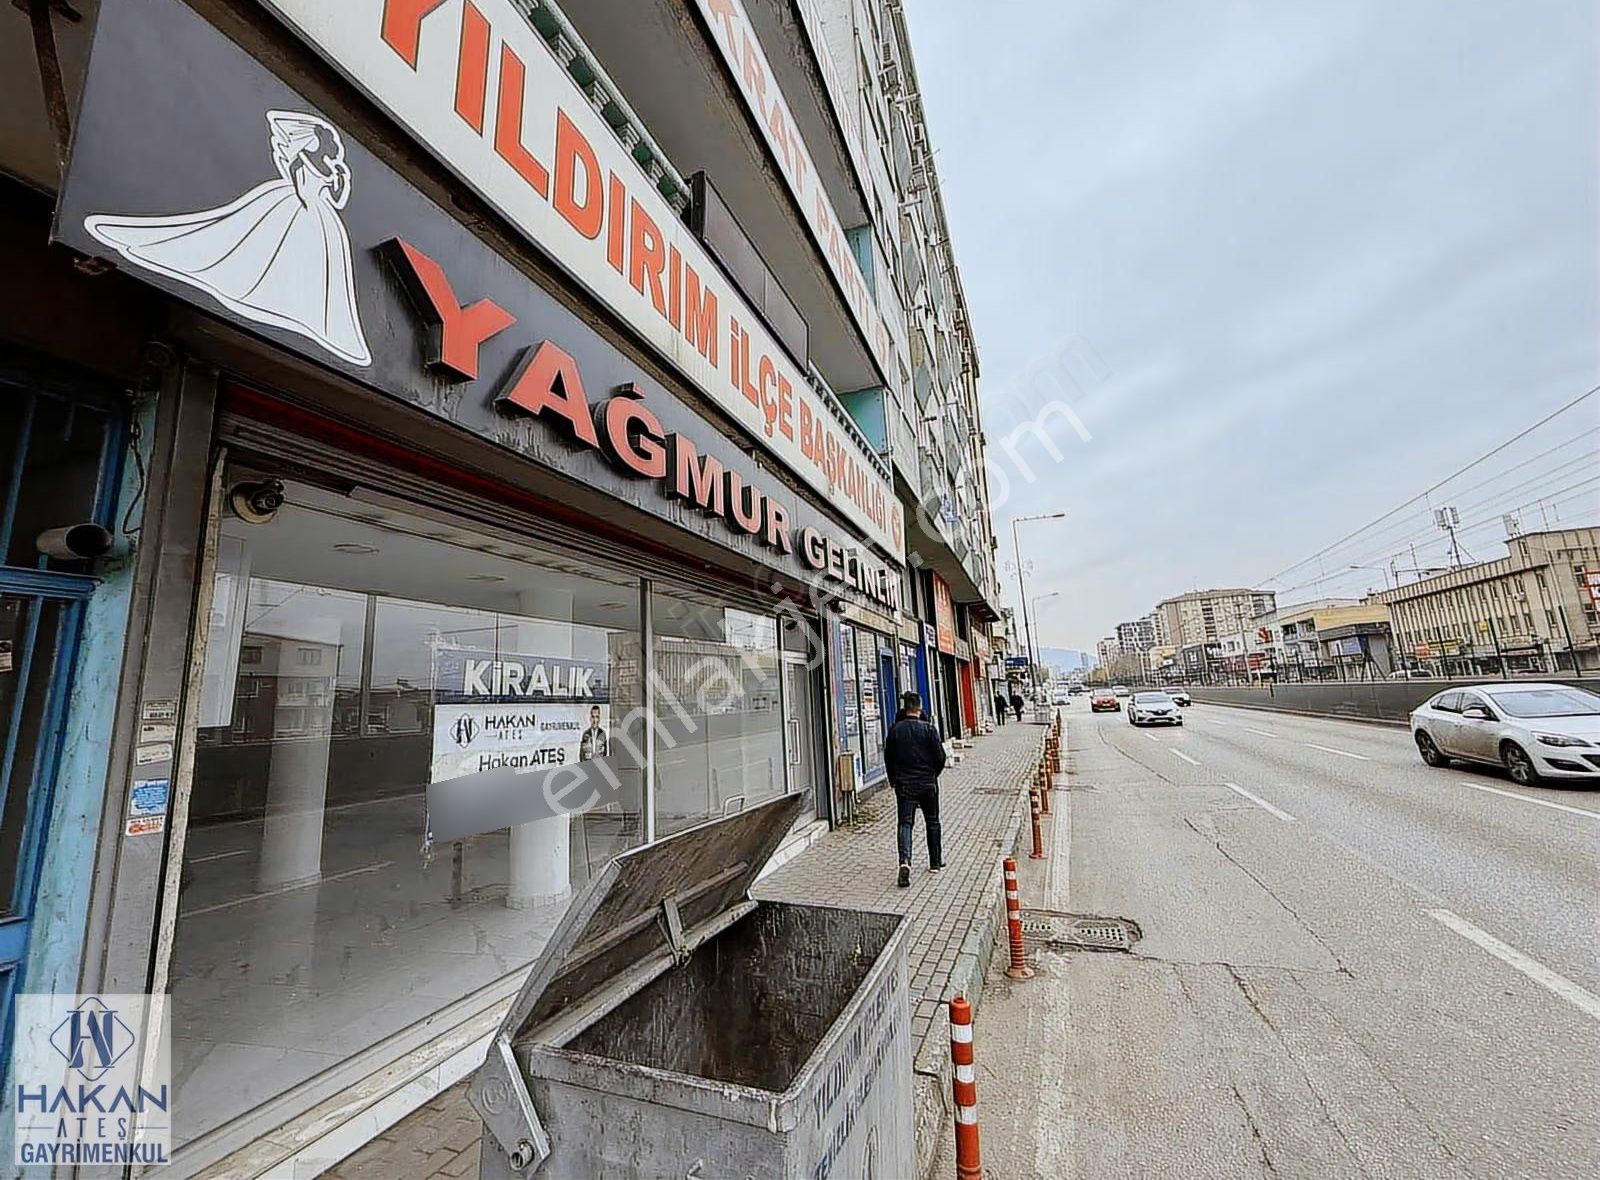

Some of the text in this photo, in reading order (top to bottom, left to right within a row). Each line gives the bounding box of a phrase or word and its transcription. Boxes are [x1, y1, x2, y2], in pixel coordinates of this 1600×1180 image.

[396, 236, 793, 556] YAĞMUR
[730, 316, 794, 443] İLÇE
[799, 397, 888, 534] BAŞKANLIĞI
[463, 659, 595, 698] KİRALIK
[485, 714, 536, 730] HAKAN
[479, 748, 566, 771] Hakan ATEŞ
